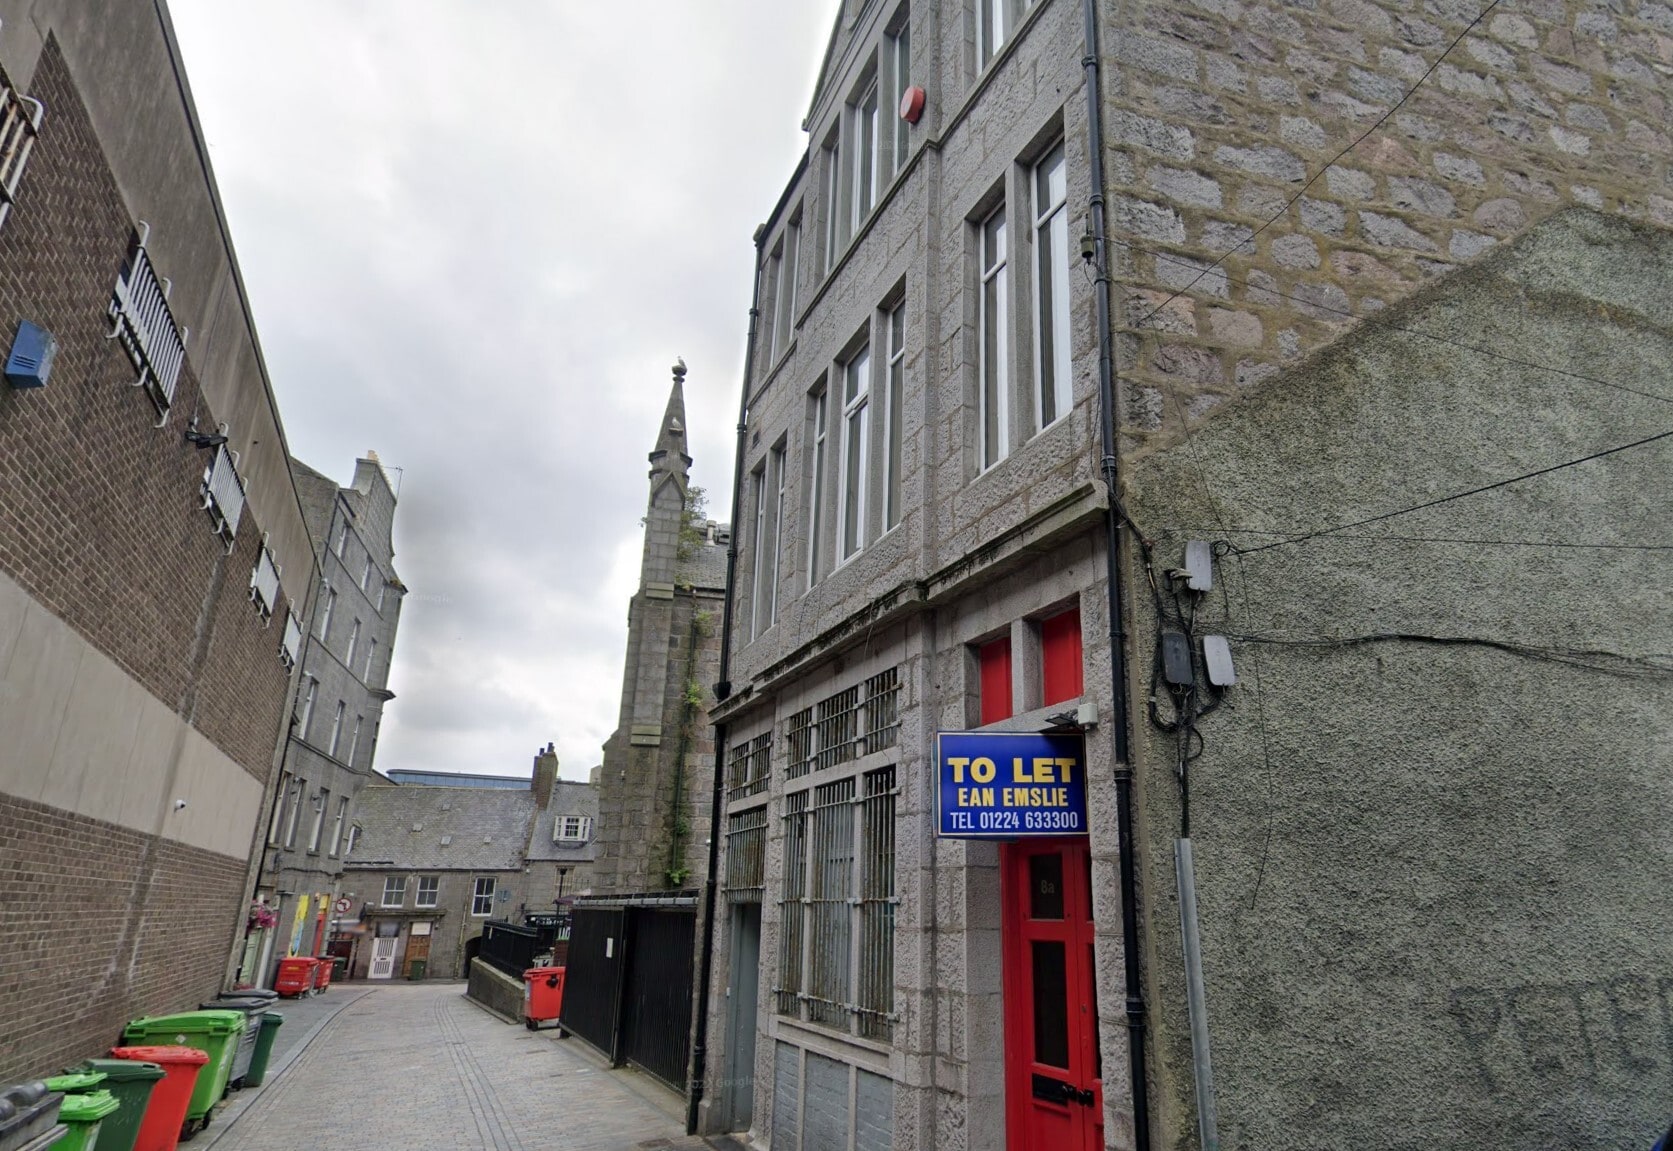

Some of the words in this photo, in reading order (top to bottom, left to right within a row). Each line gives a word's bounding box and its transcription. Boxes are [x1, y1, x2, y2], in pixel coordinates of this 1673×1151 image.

[947, 757, 996, 783] TO
[1013, 757, 1076, 783] LET
[958, 788, 994, 807] EAN
[1003, 788, 1068, 807] EMSLIE
[950, 812, 975, 829] TEL
[980, 811, 1020, 829] 01224
[1025, 811, 1078, 829] 633300
[1040, 879, 1055, 894] 8a
